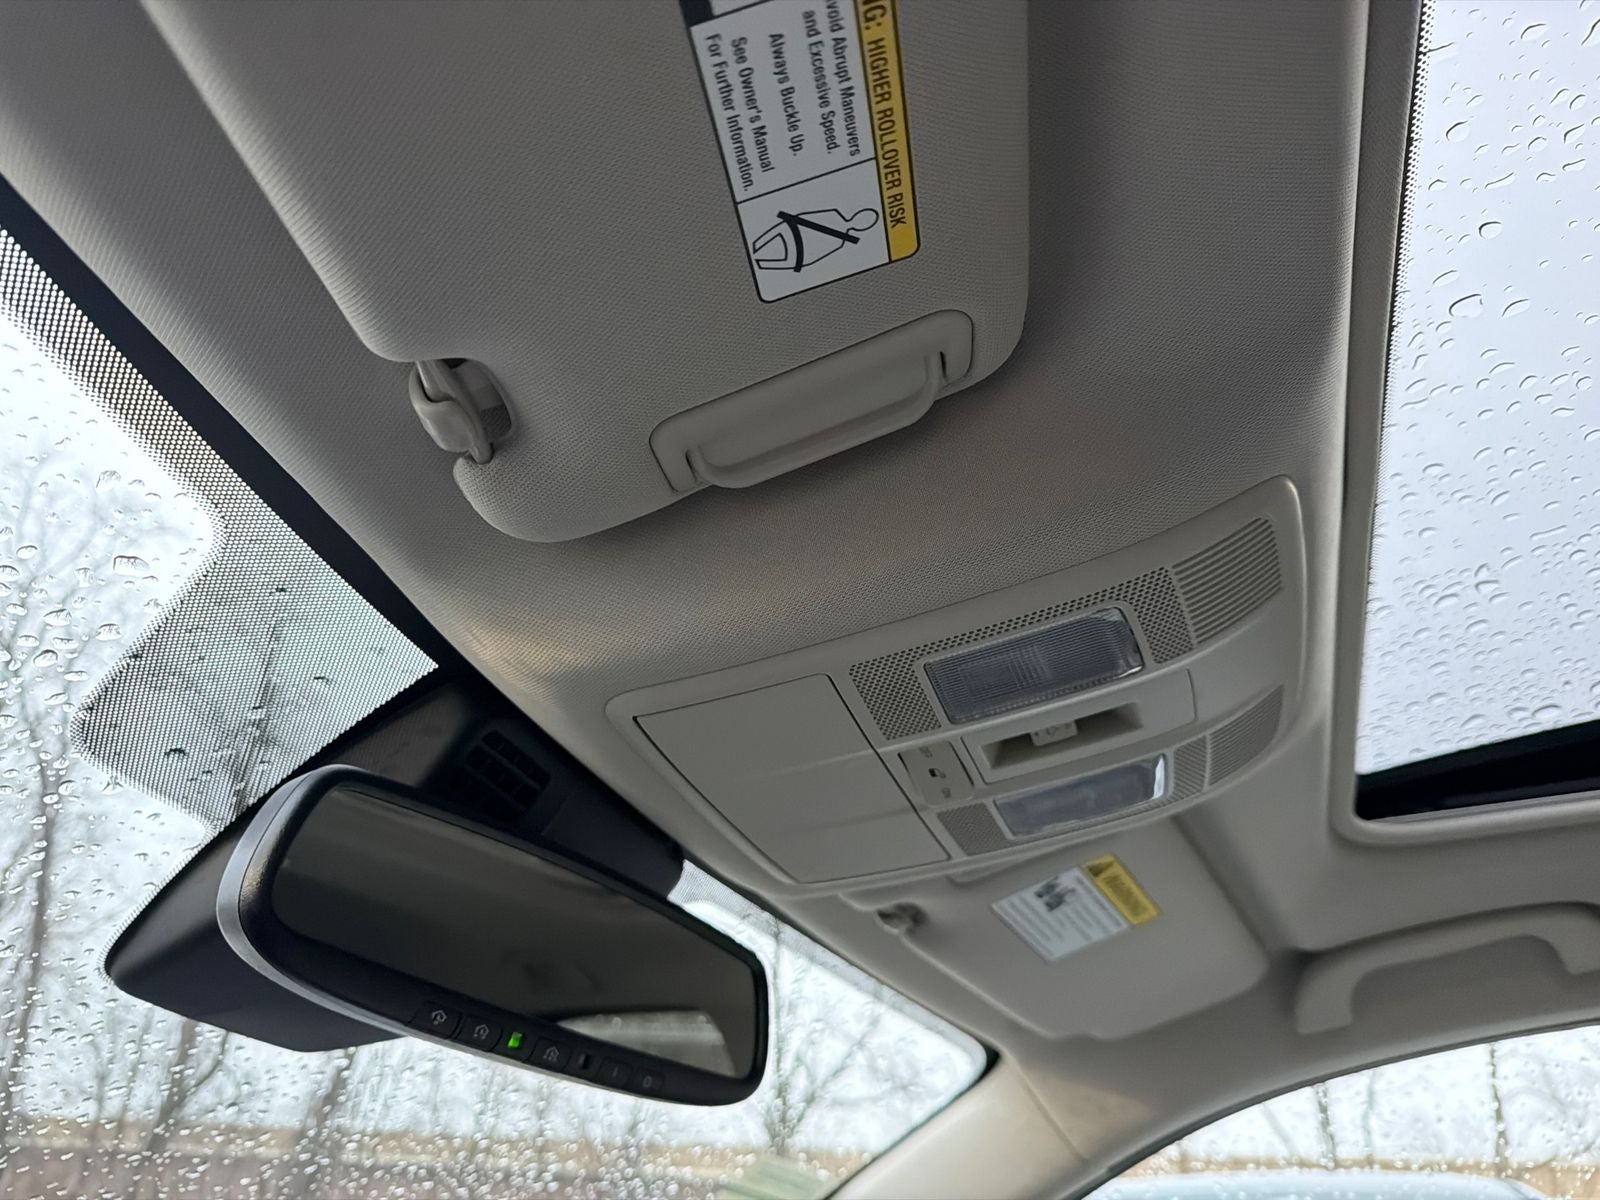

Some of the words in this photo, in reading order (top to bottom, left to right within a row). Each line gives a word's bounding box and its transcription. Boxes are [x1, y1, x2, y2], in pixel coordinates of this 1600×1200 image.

[803, 10, 822, 39] and
[826, 0, 845, 33] void
[862, 0, 887, 30] G:
[705, 33, 722, 58] For
[731, 36, 748, 65] See
[769, 33, 789, 85] Always
[832, 37, 852, 85] Abrupt
[712, 60, 737, 112] Further
[738, 67, 763, 124] Owner's
[808, 40, 831, 109] Excessive
[868, 37, 893, 106] HIGHER
[780, 86, 802, 133] Buckle
[819, 111, 840, 154] Speed.
[840, 86, 861, 157] Maneuvers
[726, 114, 754, 192] Information.
[752, 125, 775, 173] Manual
[789, 134, 805, 156] Up.
[876, 108, 902, 190] ROLLOVER
[887, 192, 907, 228] RISK
